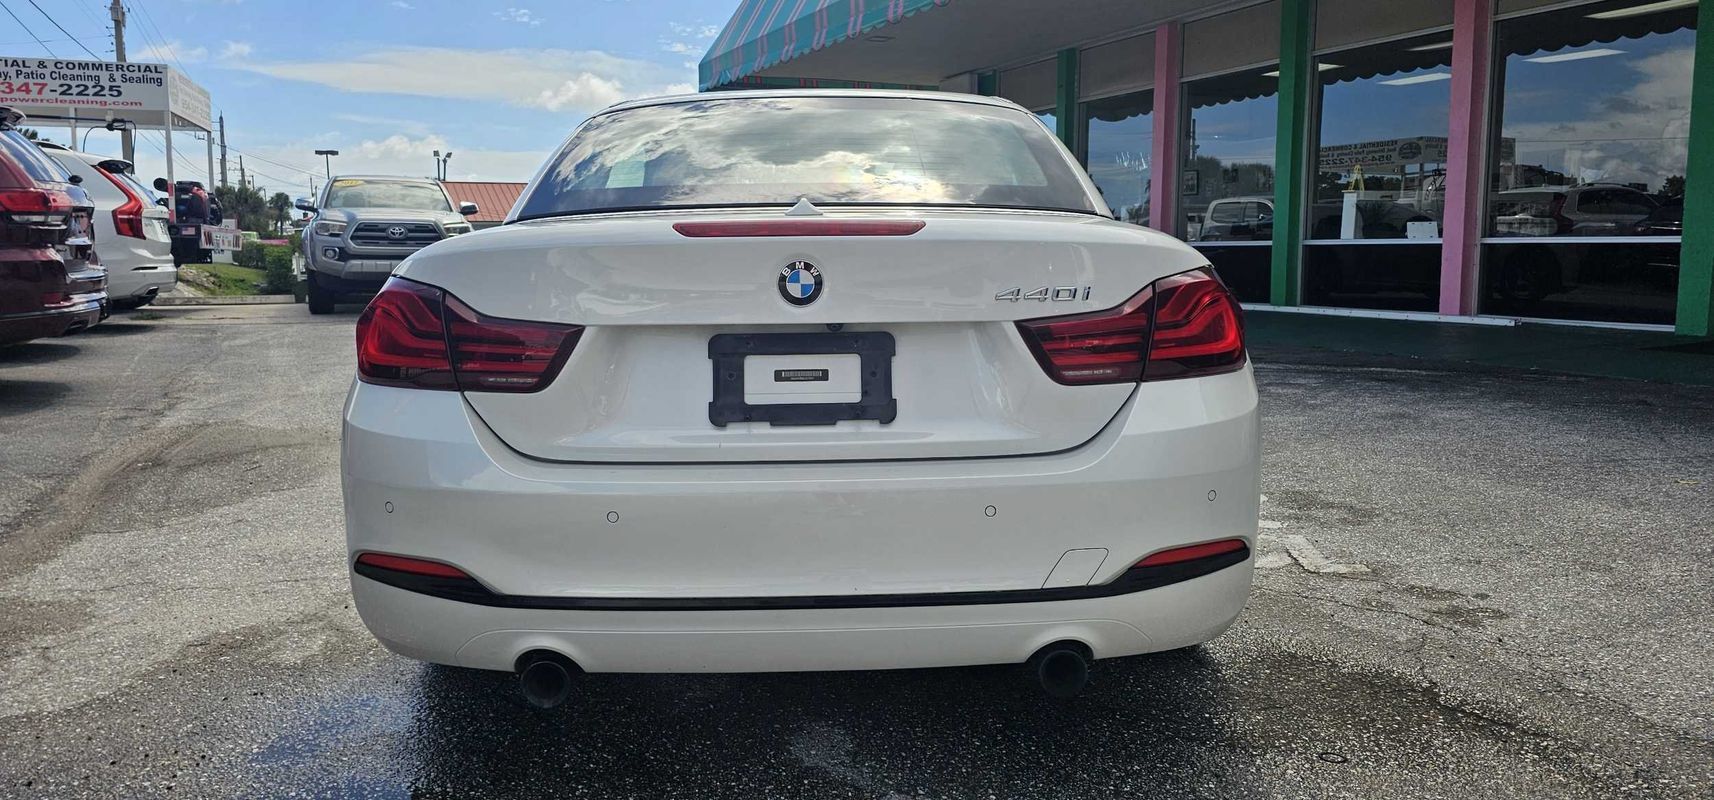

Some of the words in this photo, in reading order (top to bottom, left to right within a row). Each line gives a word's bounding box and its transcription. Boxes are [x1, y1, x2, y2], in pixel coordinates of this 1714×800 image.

[37, 60, 48, 69] &
[54, 61, 164, 74] COMMERCIAL
[15, 69, 46, 80] Patio
[49, 70, 101, 84] Cleaning
[108, 73, 117, 83] &
[120, 73, 163, 87] Sealing
[0, 81, 123, 97] 347-2225
[781, 261, 819, 277] BMW
[995, 286, 1091, 302] 440i
